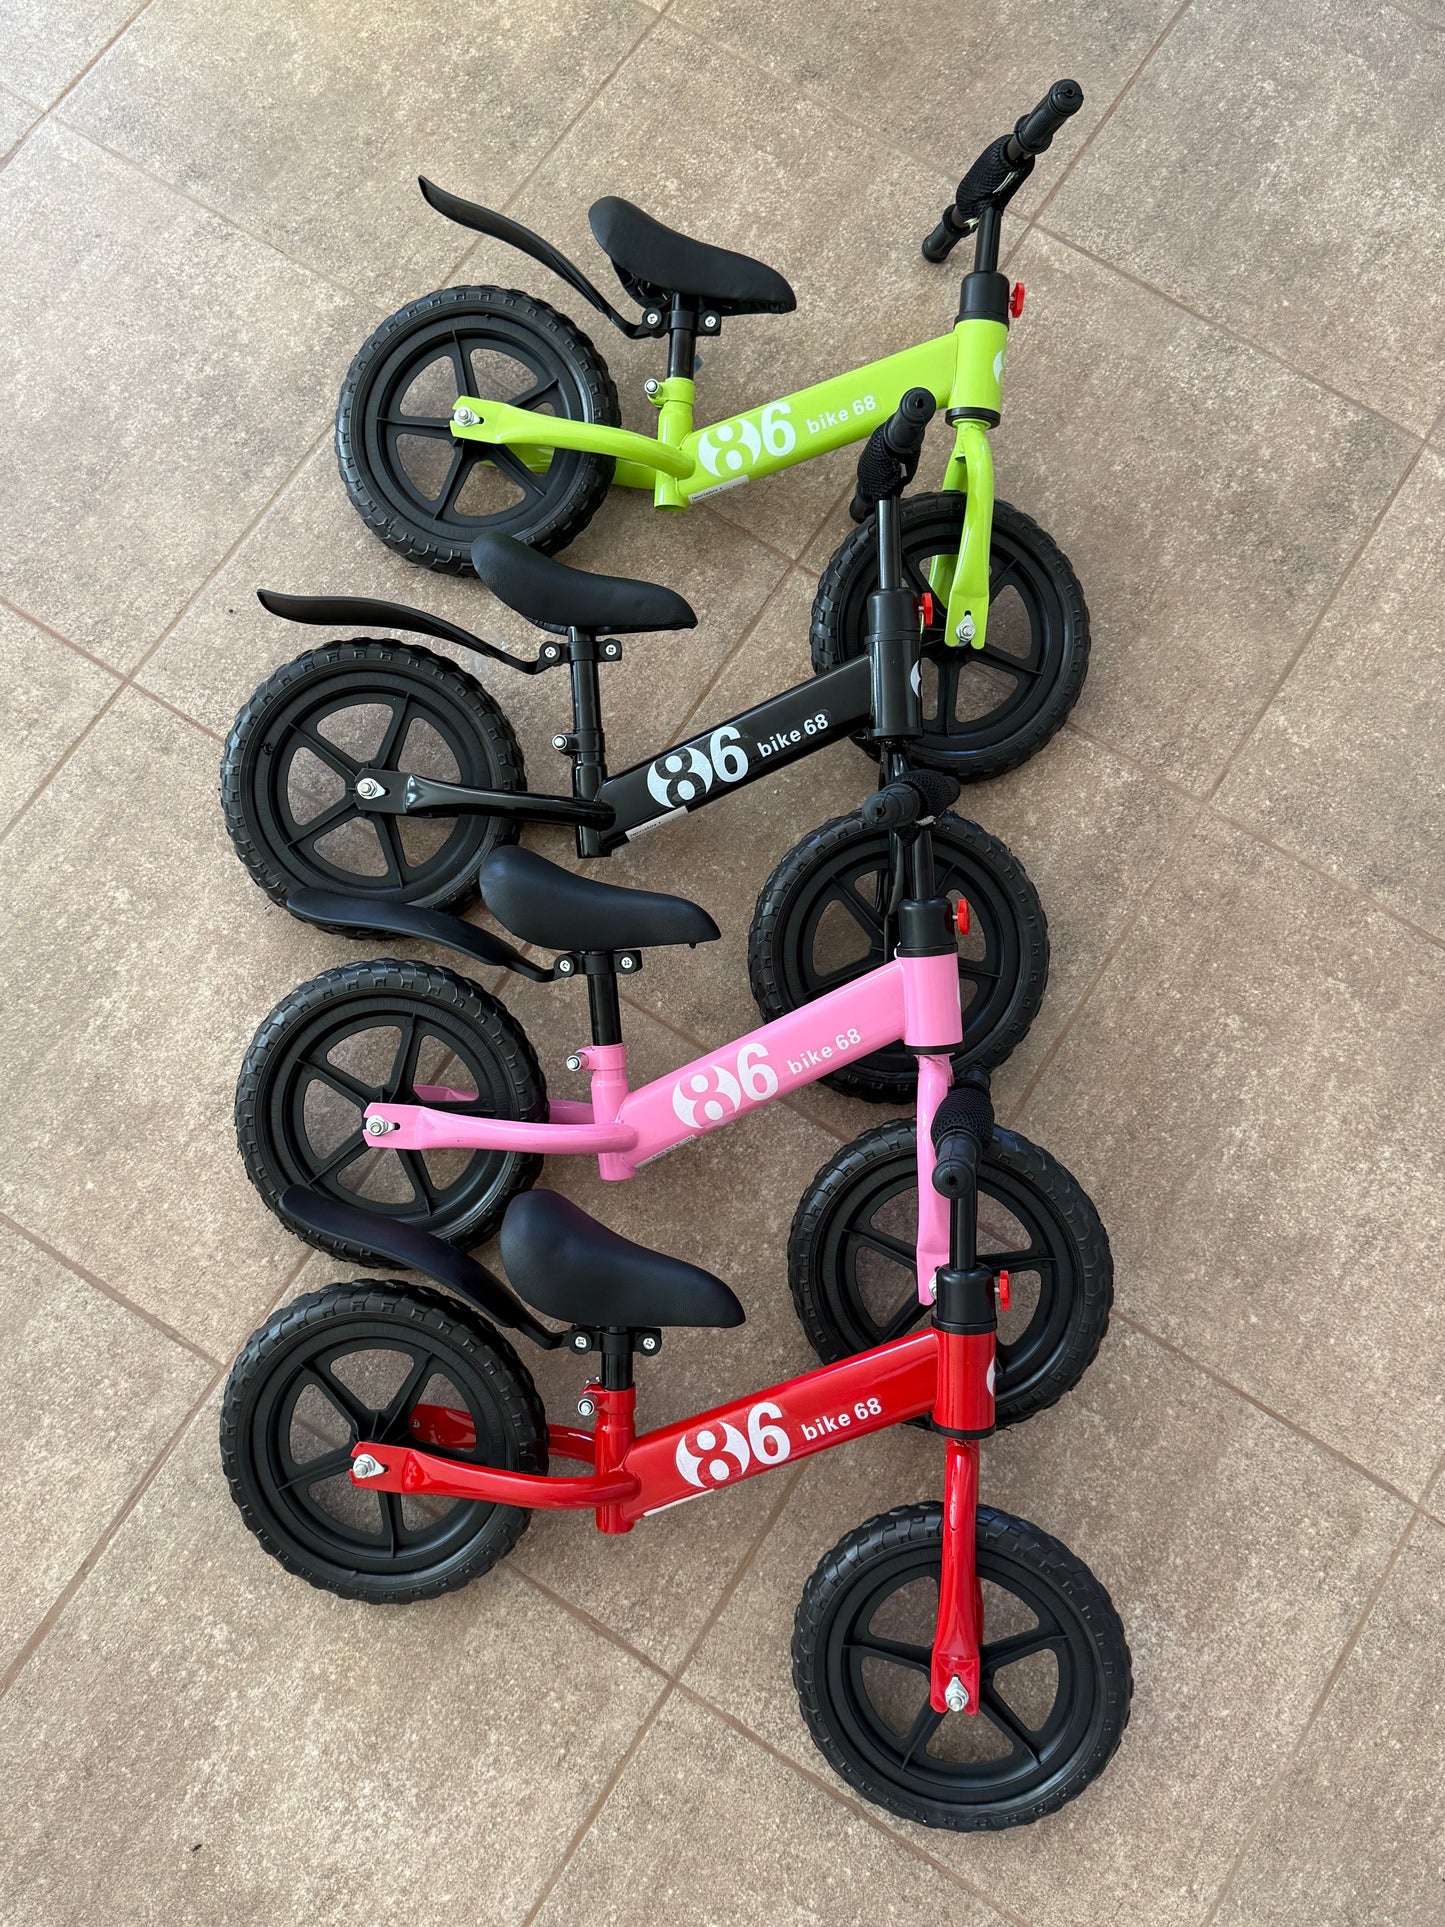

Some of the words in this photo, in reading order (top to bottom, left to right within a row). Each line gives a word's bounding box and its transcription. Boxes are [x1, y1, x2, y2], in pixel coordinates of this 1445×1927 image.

[698, 401, 797, 478] 86
[806, 408, 849, 434] bike
[852, 395, 876, 416] 68
[646, 725, 749, 808] 86
[757, 728, 802, 758] bike
[803, 713, 829, 733] 68
[672, 1042, 779, 1129] 86
[787, 1045, 833, 1075] bike
[835, 1028, 862, 1051] 68
[675, 1401, 791, 1488] 86
[800, 1412, 851, 1441] bike
[853, 1397, 882, 1420] 68
